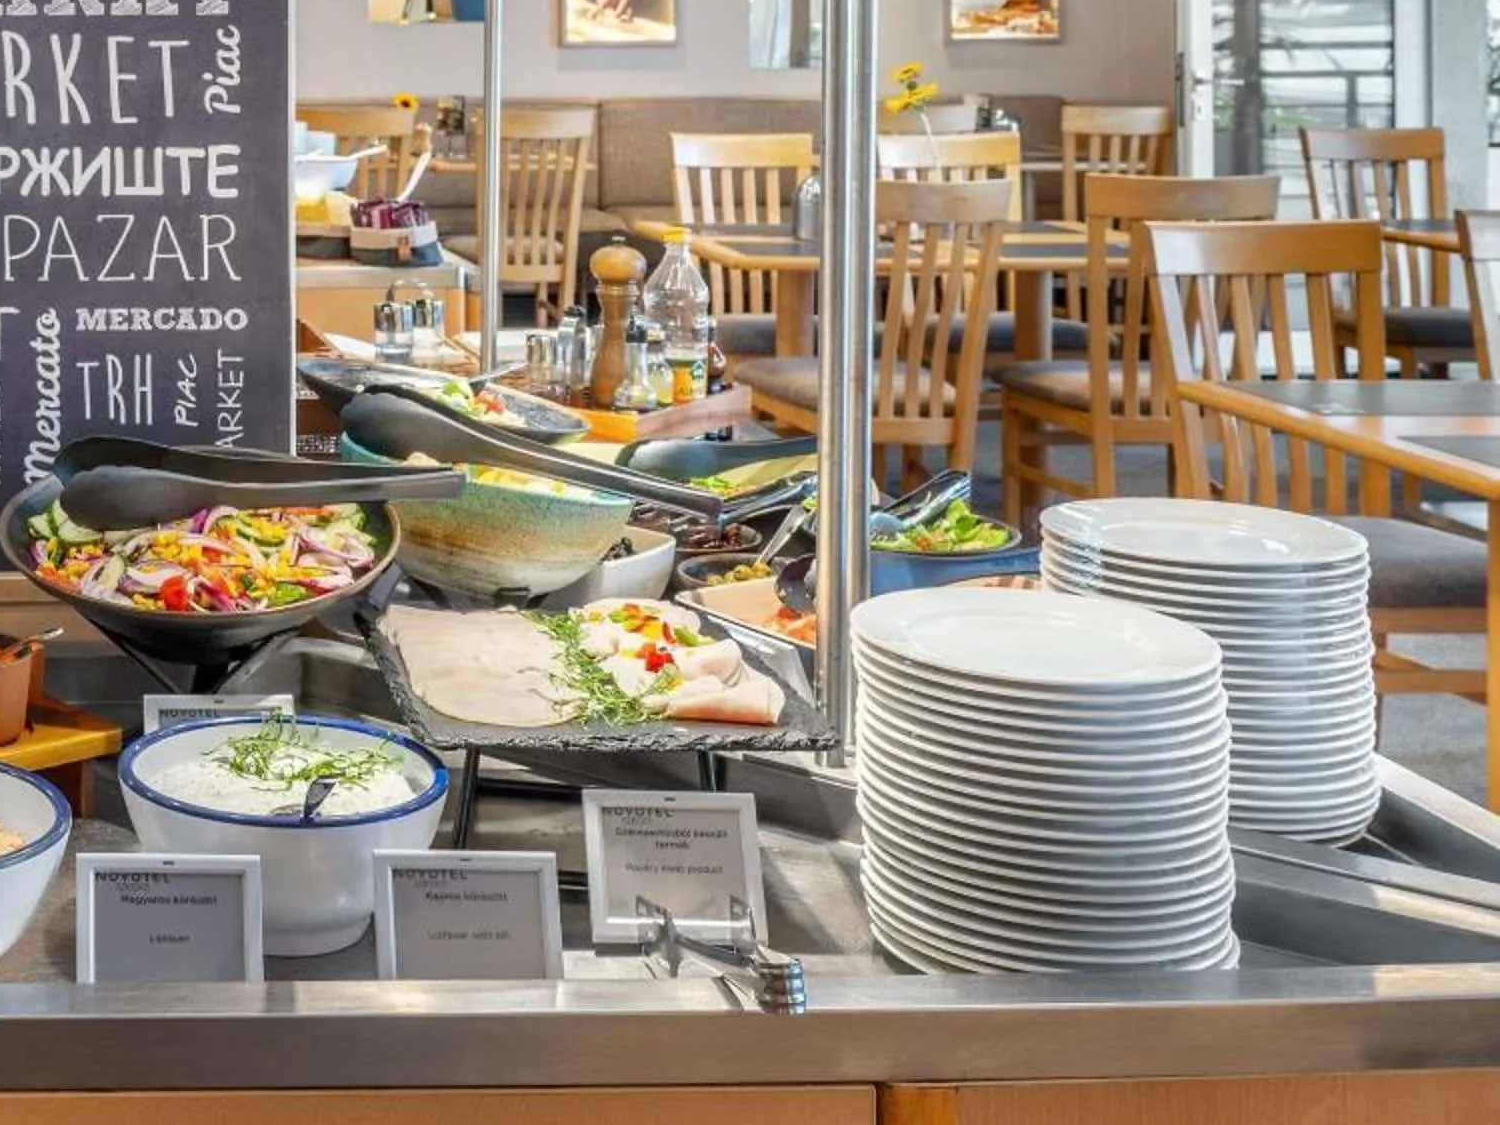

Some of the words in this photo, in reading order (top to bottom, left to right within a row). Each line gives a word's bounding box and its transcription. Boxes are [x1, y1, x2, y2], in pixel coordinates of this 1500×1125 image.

[202, 24, 242, 115] Piac
[2, 214, 242, 283] PAZAR
[75, 307, 249, 333] MERCADO
[75, 353, 154, 426] TRH
[215, 348, 245, 448] ARKET
[158, 708, 221, 719] NOVOTEL
[601, 806, 676, 818] NOVOTEL
[95, 872, 170, 884] NOVOTEL
[393, 868, 469, 880] NOVOTEL
